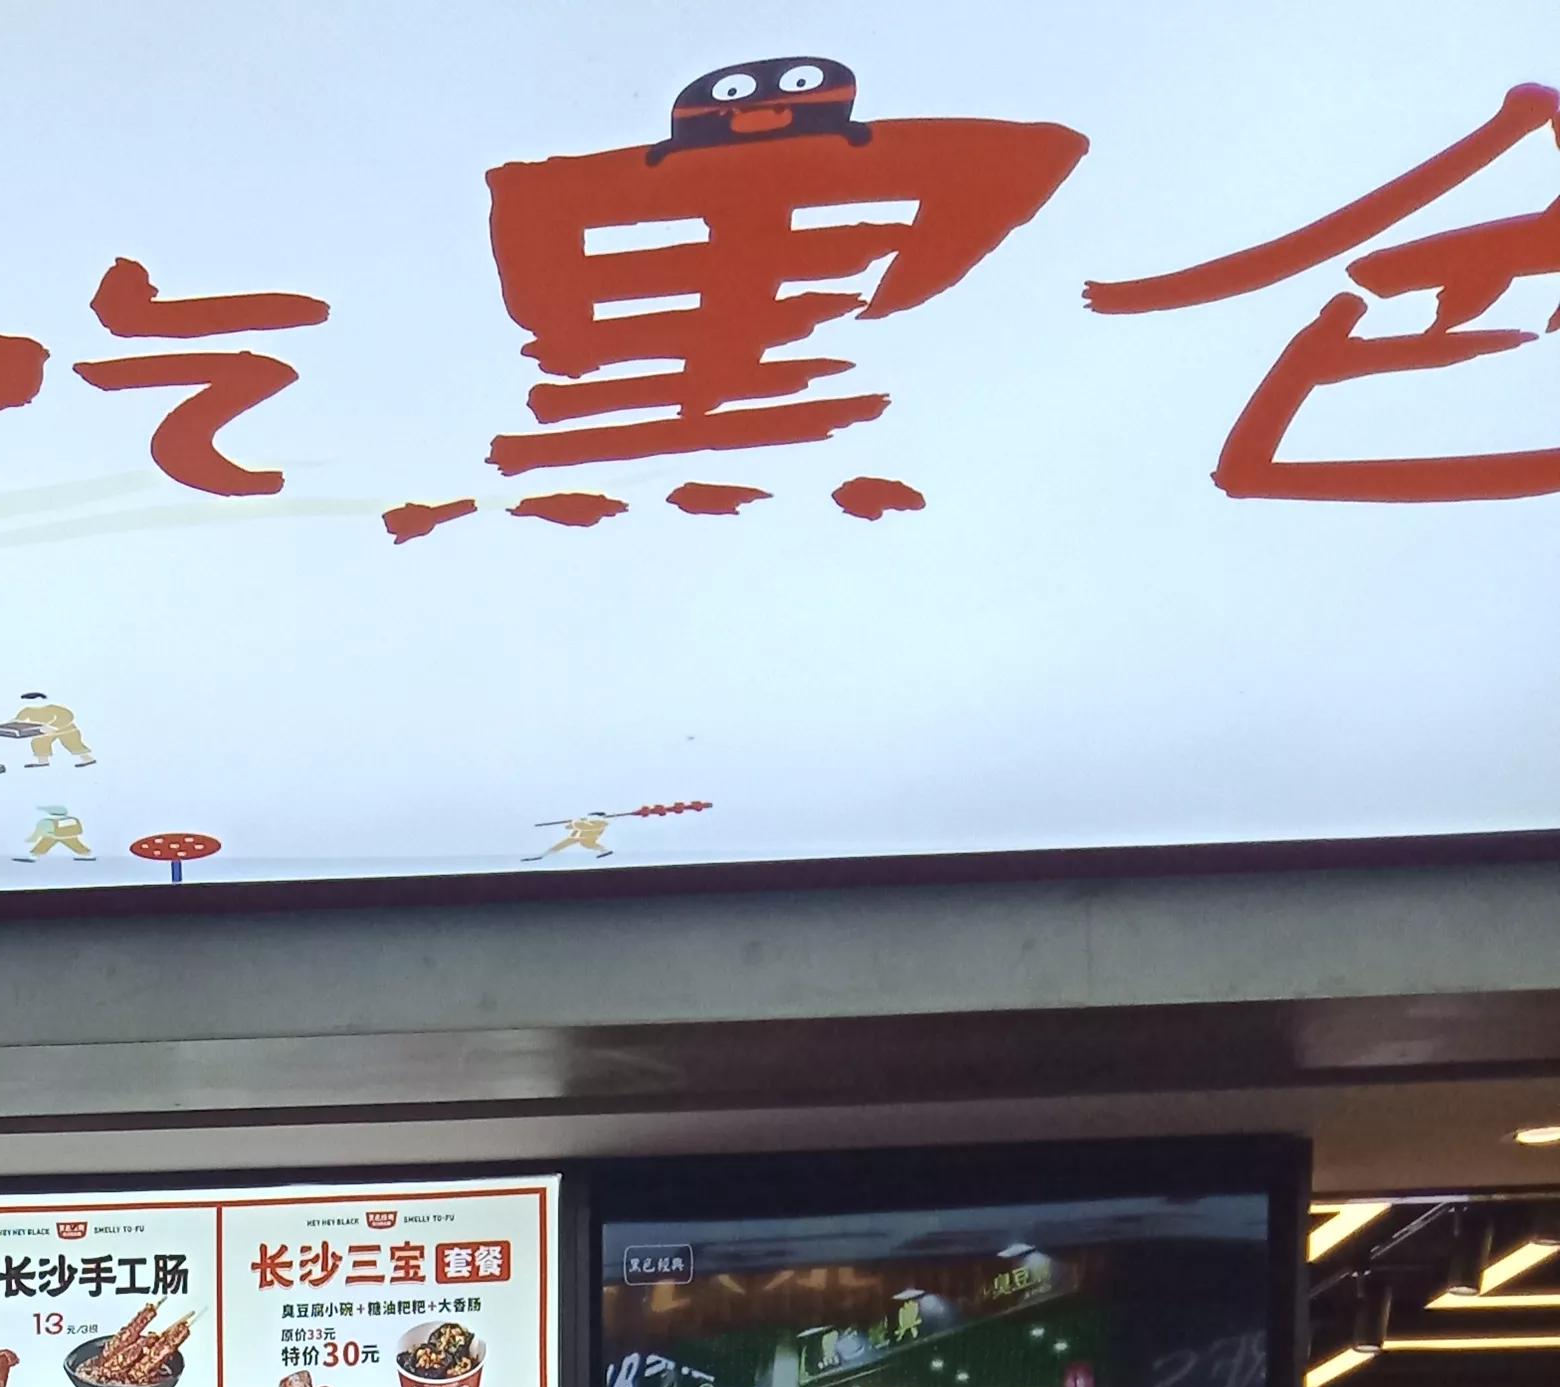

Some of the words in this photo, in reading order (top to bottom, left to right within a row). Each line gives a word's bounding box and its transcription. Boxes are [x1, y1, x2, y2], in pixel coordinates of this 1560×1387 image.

[251, 1240, 426, 1290] 长沙三宝
[443, 1245, 504, 1278] 套餐
[281, 1327, 337, 1342] 原价33元
[281, 1341, 380, 1368] 特价30元
